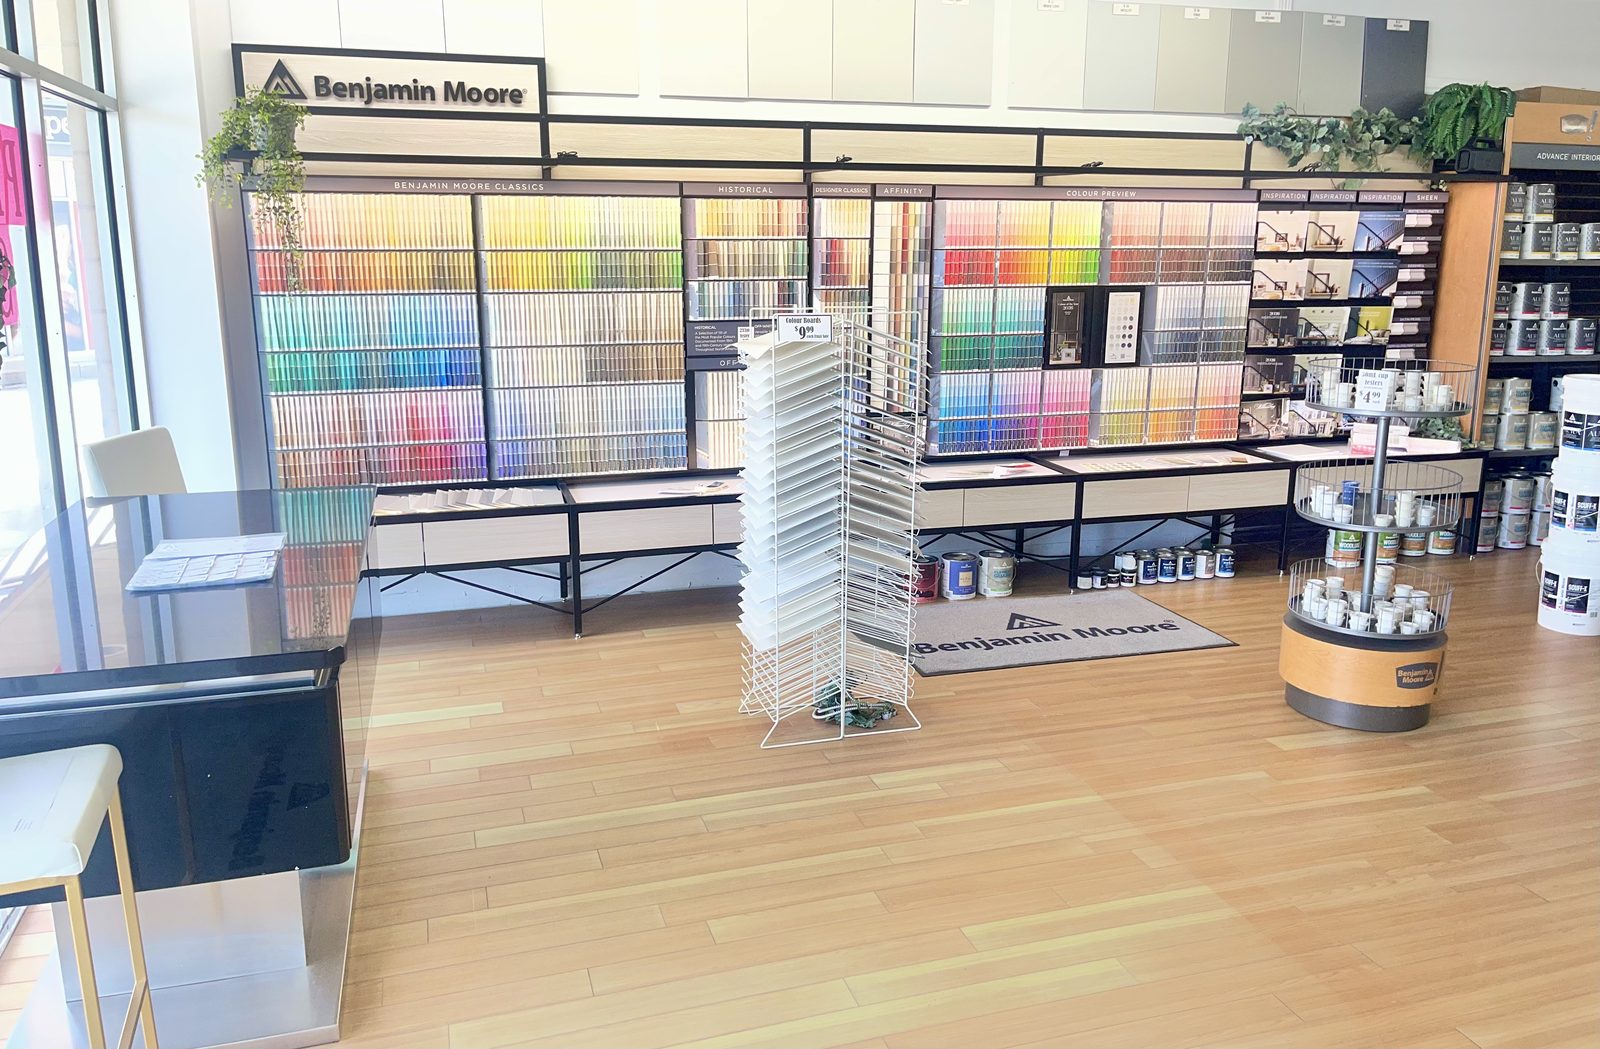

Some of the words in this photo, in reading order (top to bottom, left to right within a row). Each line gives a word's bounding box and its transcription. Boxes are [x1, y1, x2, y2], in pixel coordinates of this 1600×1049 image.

[314, 75, 436, 105] Benjamin
[443, 80, 524, 105] Moore
[1537, 152, 1568, 161] ADVANCE
[394, 181, 449, 190] BENJAMIN
[453, 182, 491, 191] MOORE
[495, 182, 544, 192] CLASSICS
[718, 186, 774, 194] HISTORICAL
[883, 187, 924, 195] AFFINITY
[1066, 189, 1100, 197] COLOUR
[1101, 190, 1137, 198] PREVIEW
[1263, 192, 1307, 200] INSPIRATION
[1312, 192, 1355, 200] INSPIRATION
[1360, 193, 1402, 201] INSPIRATION
[914, 631, 1072, 655] Benjamin
[1072, 620, 1181, 640] Moore
